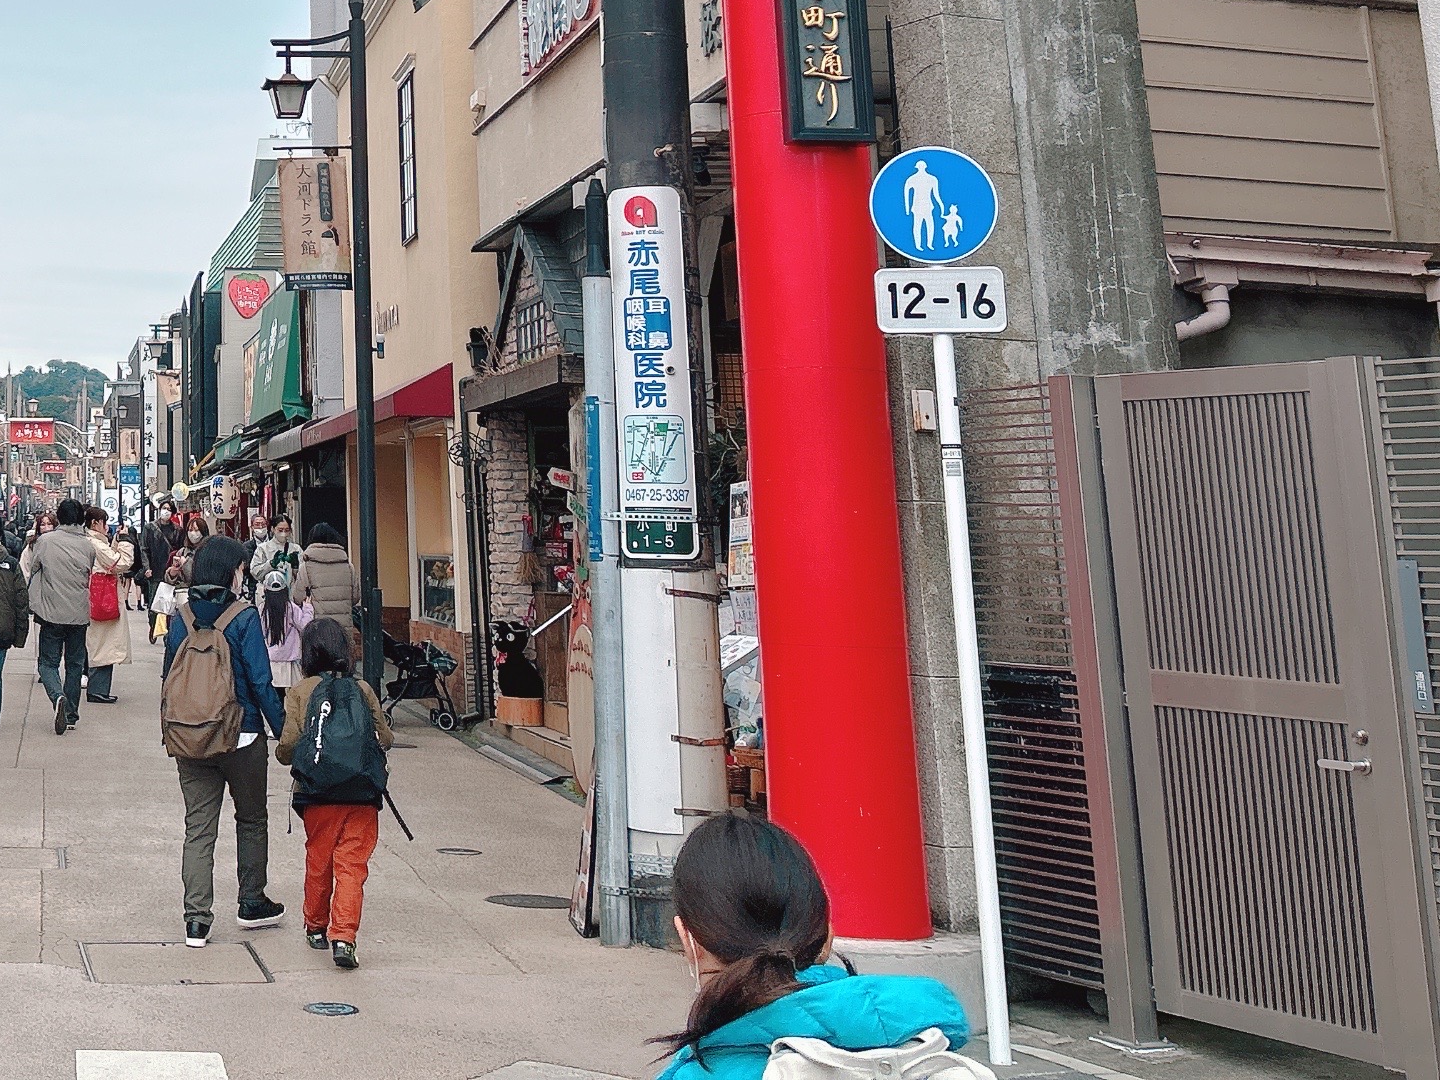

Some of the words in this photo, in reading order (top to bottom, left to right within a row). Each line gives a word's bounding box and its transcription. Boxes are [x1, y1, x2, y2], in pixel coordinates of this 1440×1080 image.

[296, 163, 317, 256] 大河ドラマ館
[627, 239, 661, 296] 赤尾
[887, 281, 997, 320] 12-16
[633, 353, 667, 408] 医院
[15, 428, 49, 439] 小町通り
[625, 488, 690, 502] 0467-25-3387
[643, 535, 675, 548] 1-5
